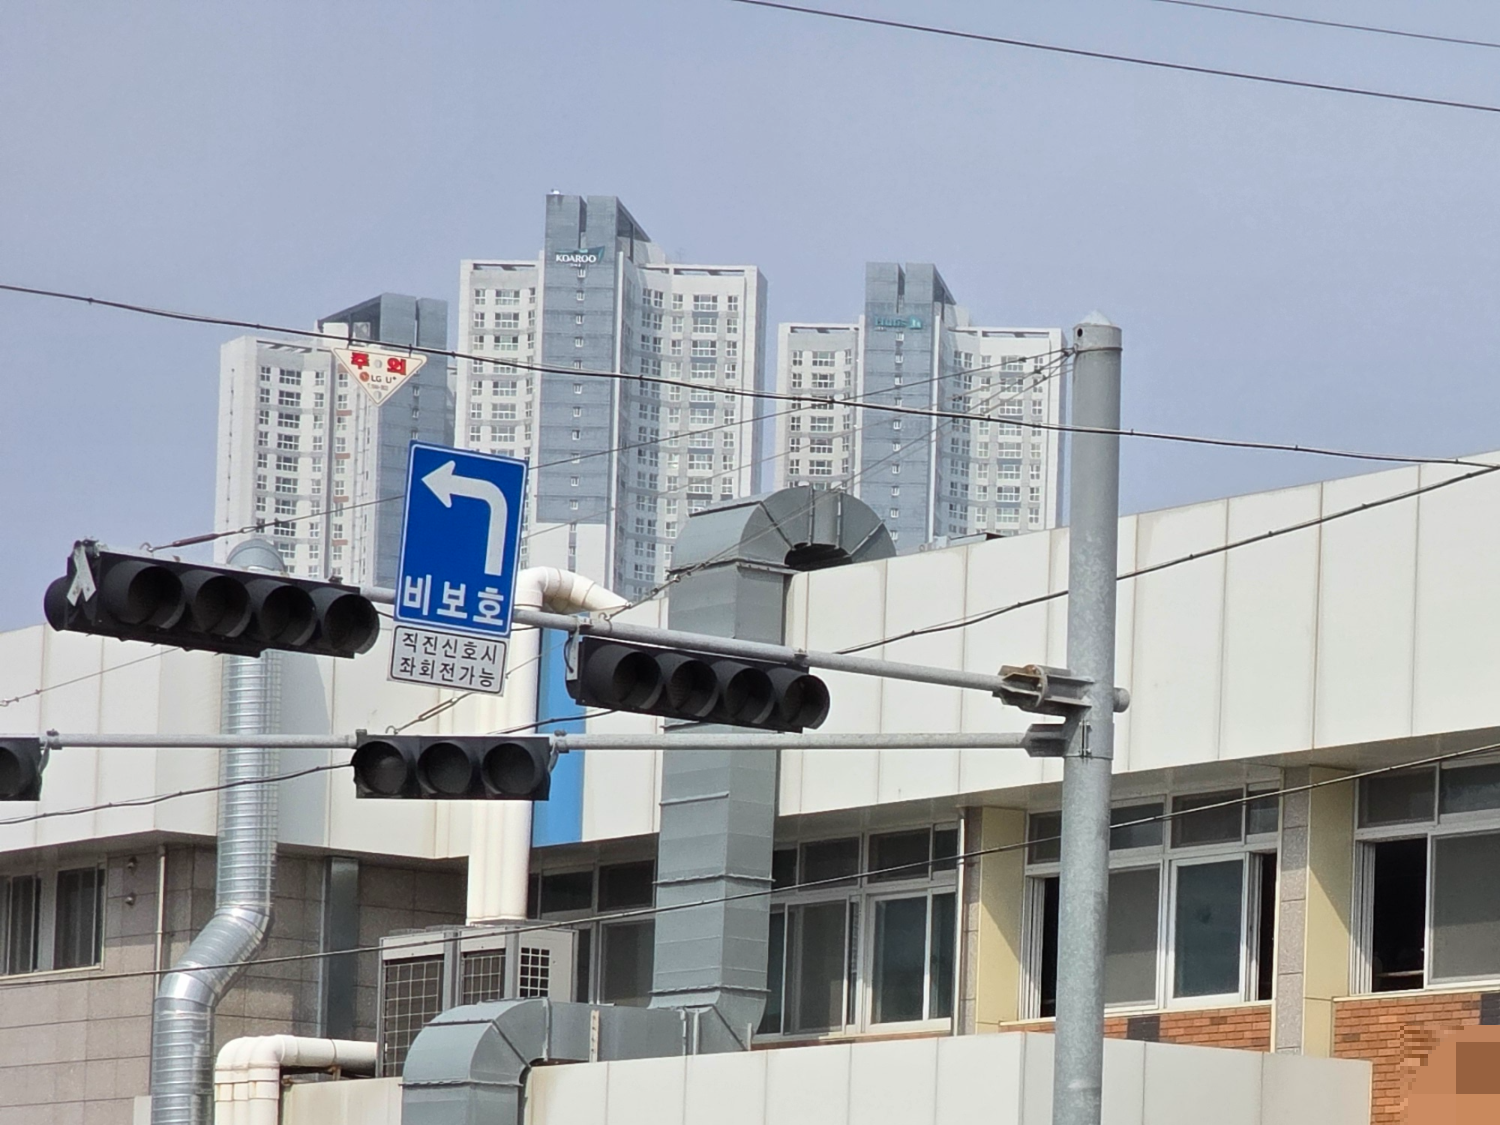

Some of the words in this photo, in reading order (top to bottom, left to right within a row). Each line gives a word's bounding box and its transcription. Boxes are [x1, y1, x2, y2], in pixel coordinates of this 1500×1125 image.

[371, 375, 382, 383] LG
[403, 574, 504, 626] 비보호
[402, 632, 497, 665] 직진신호시
[400, 656, 495, 688] 좌회전가능
